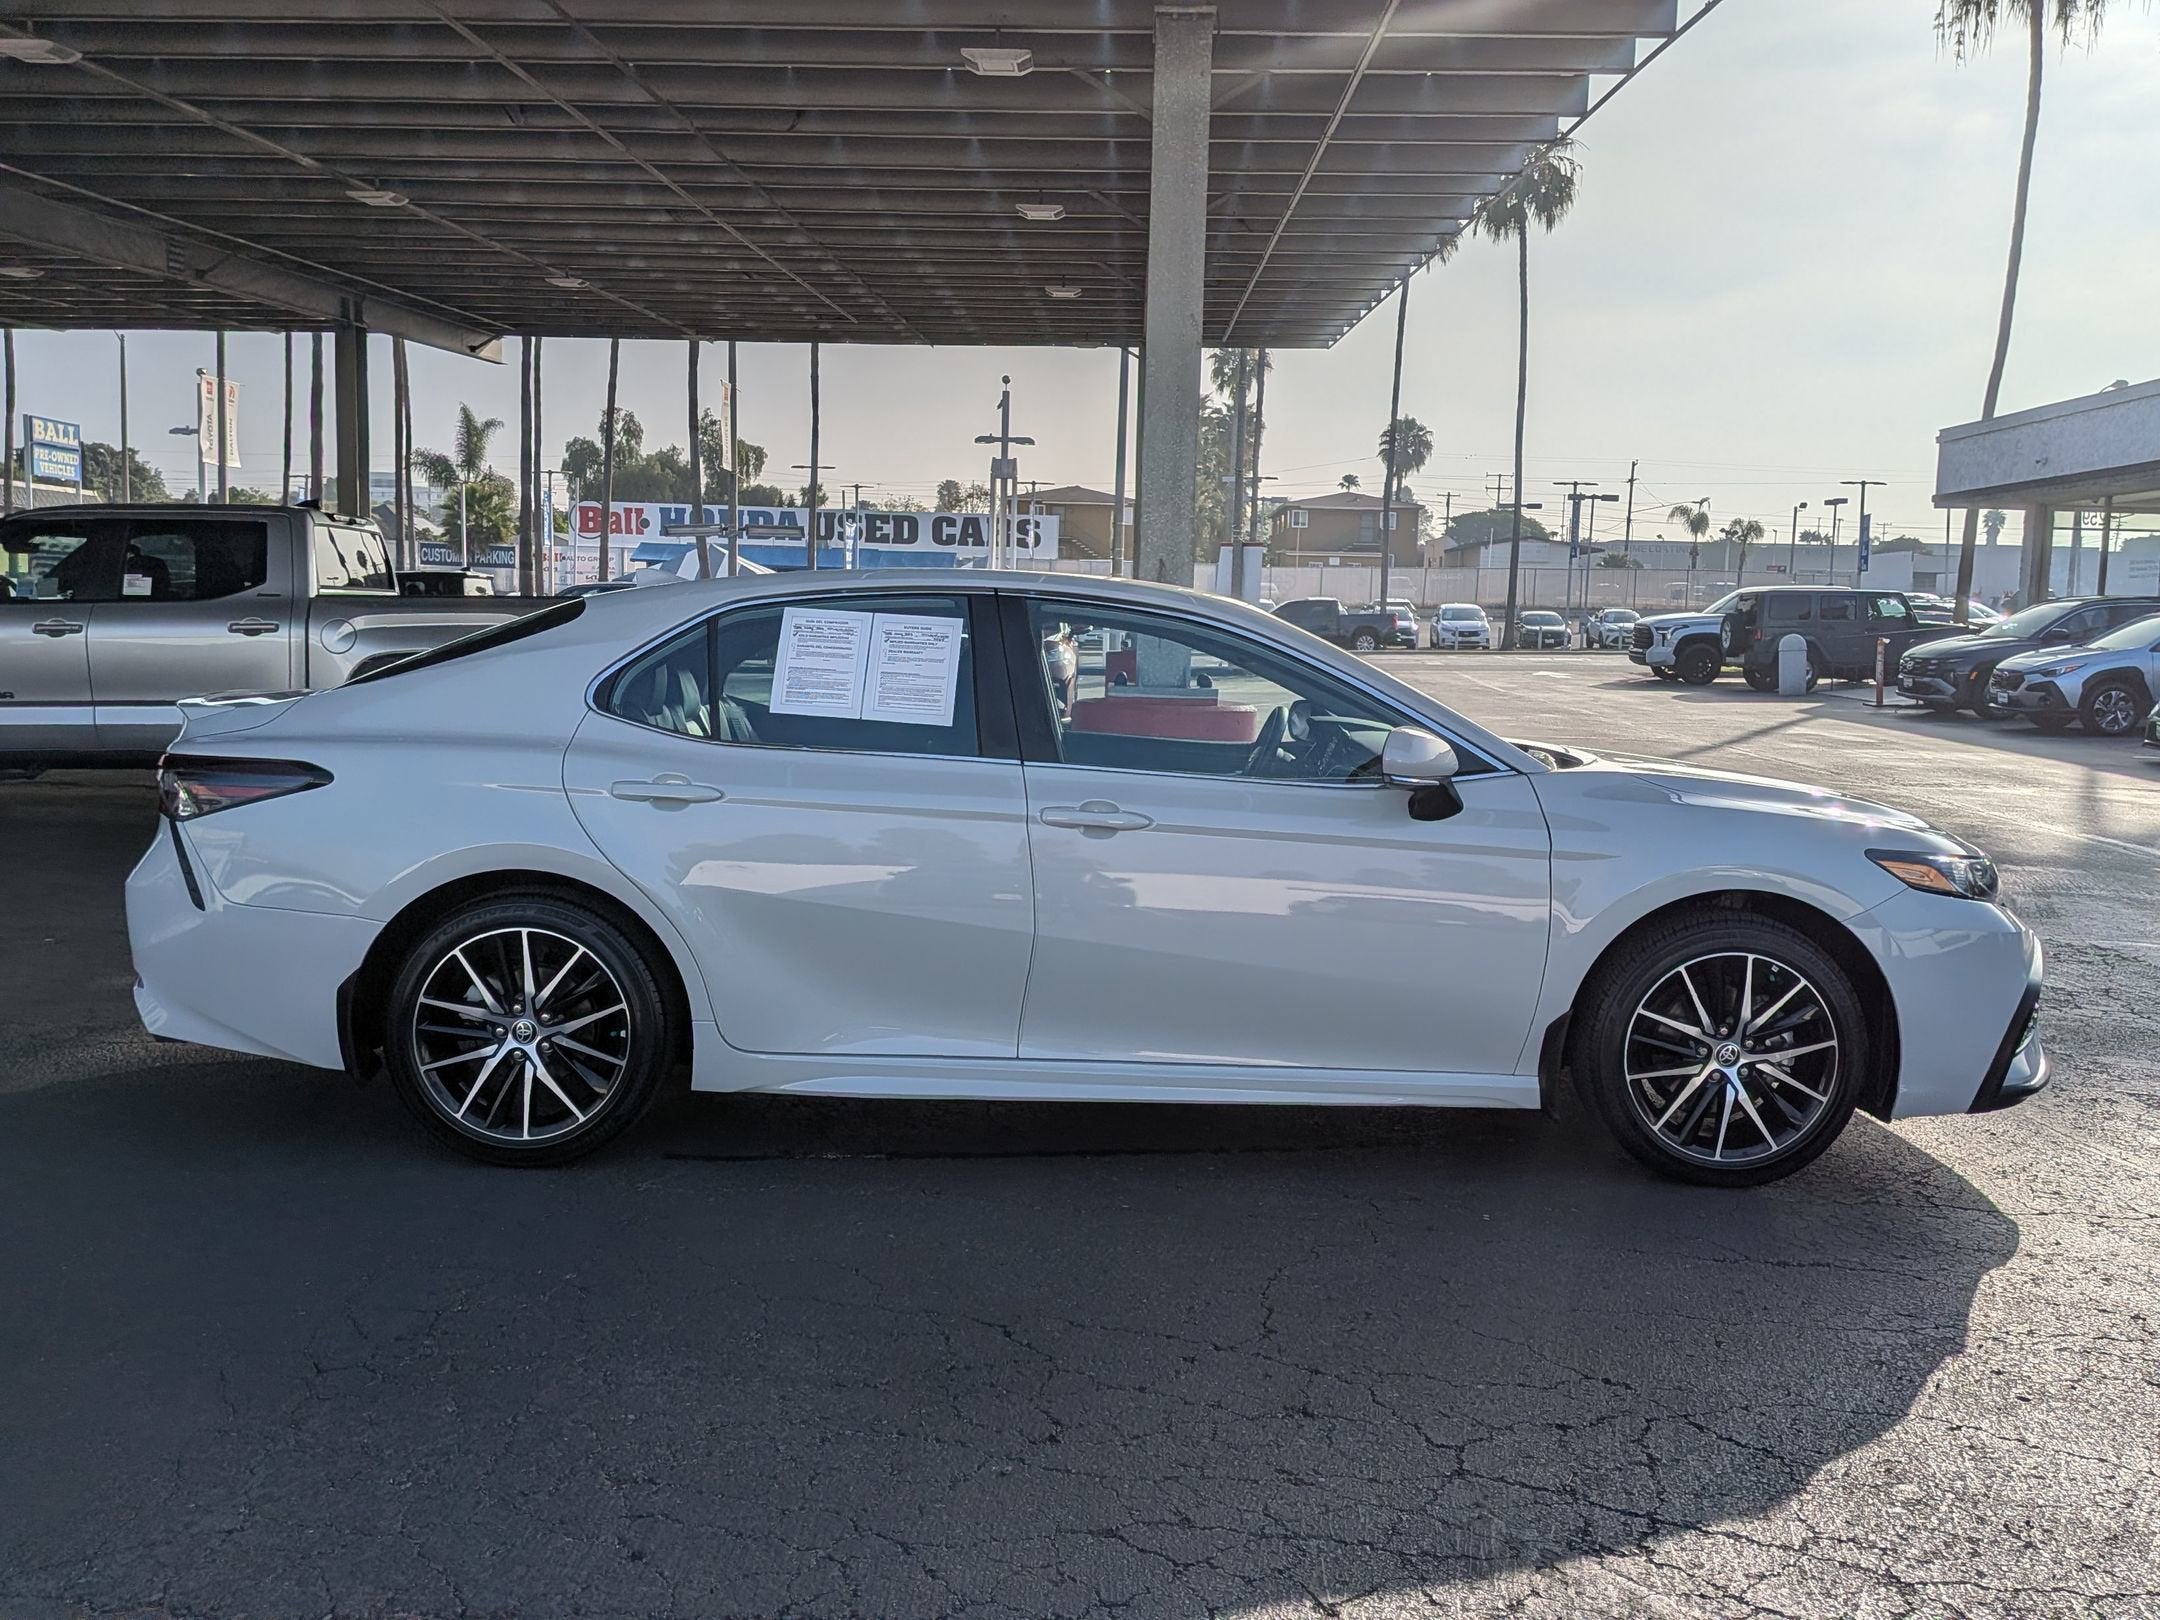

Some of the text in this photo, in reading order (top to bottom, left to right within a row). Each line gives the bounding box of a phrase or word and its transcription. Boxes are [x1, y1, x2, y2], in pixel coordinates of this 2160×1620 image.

[32, 419, 79, 446] BALL
[206, 414, 214, 451] TOYOTA
[33, 448, 79, 466] PRE-OWNED
[40, 462, 76, 477] VEHICLES
[578, 506, 645, 536] Ball
[658, 507, 805, 541] HNDA
[815, 512, 919, 545] USED
[420, 547, 515, 565] CUSTOM PARKING
